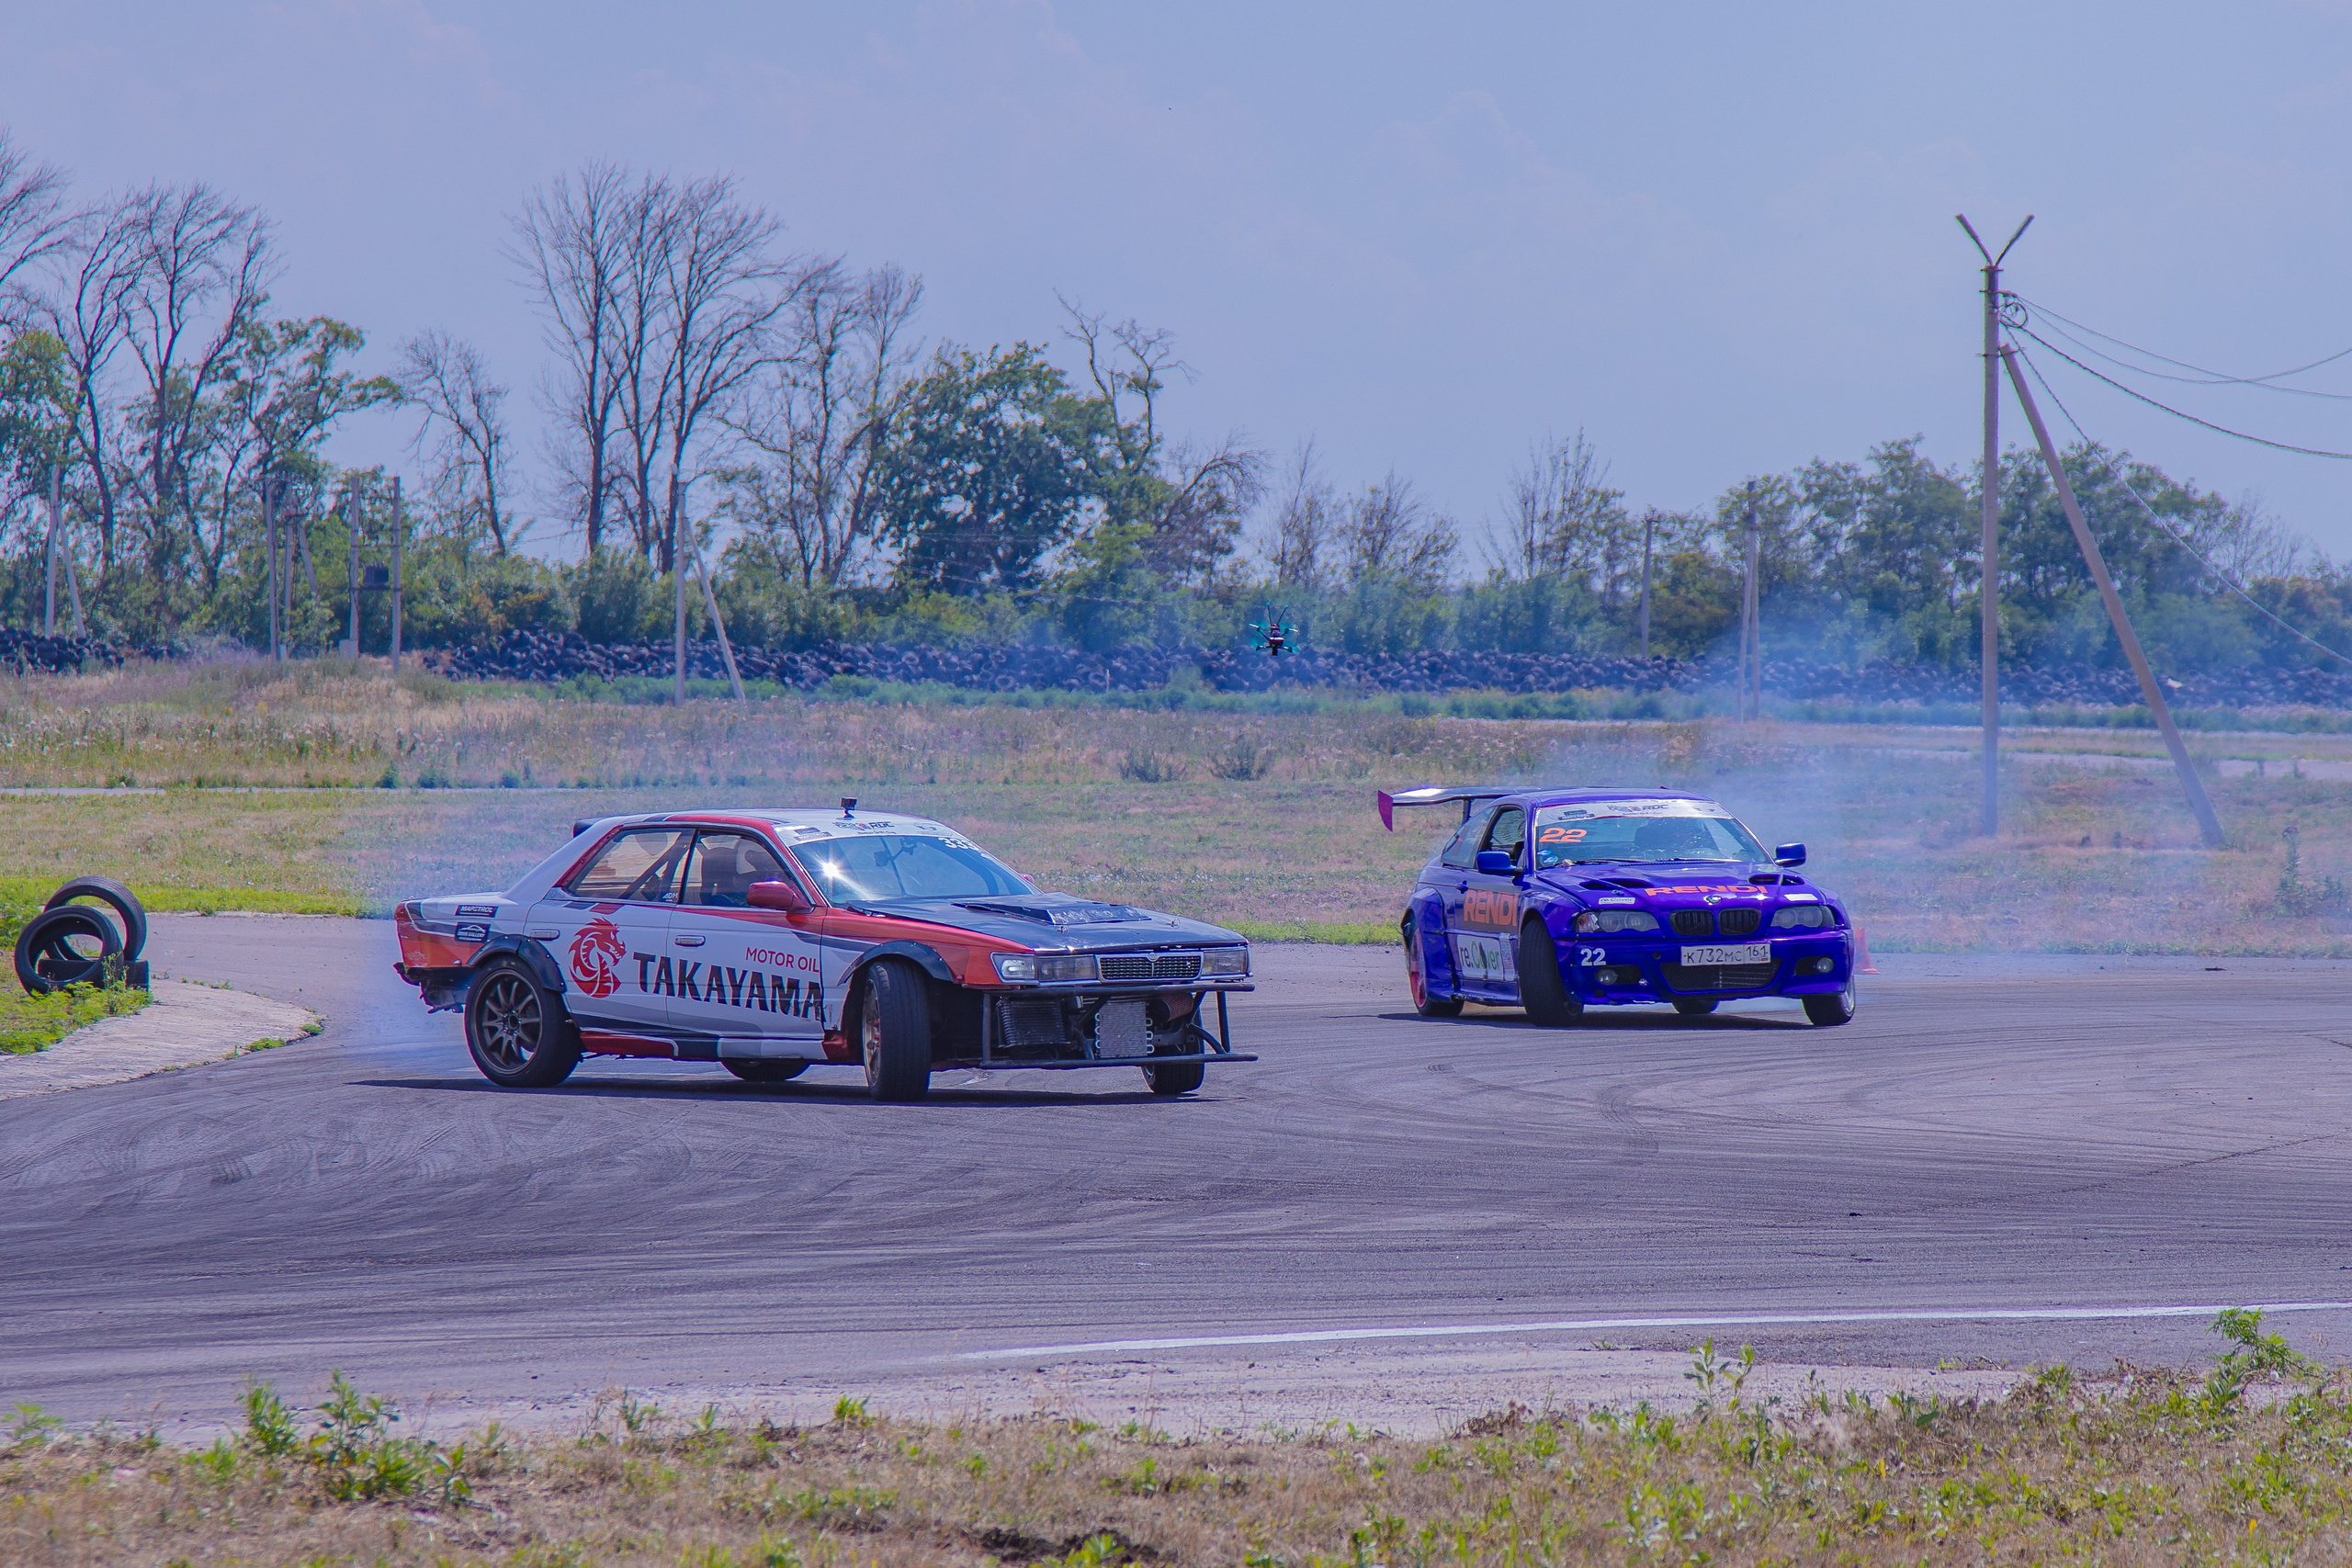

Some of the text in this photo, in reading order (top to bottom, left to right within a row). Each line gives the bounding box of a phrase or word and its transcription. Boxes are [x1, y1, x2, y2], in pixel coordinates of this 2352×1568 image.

[1642, 804, 1669, 812] RDC
[1538, 827, 1588, 843] 22
[937, 837, 979, 852] 333
[1644, 885, 1770, 896] RENDI
[1463, 888, 1521, 928] RENDI
[1580, 947, 1607, 966] 22
[1746, 945, 1768, 957] 161
[745, 946, 820, 974] MOTOR OIL
[632, 951, 827, 1023] TAKAYAMA
